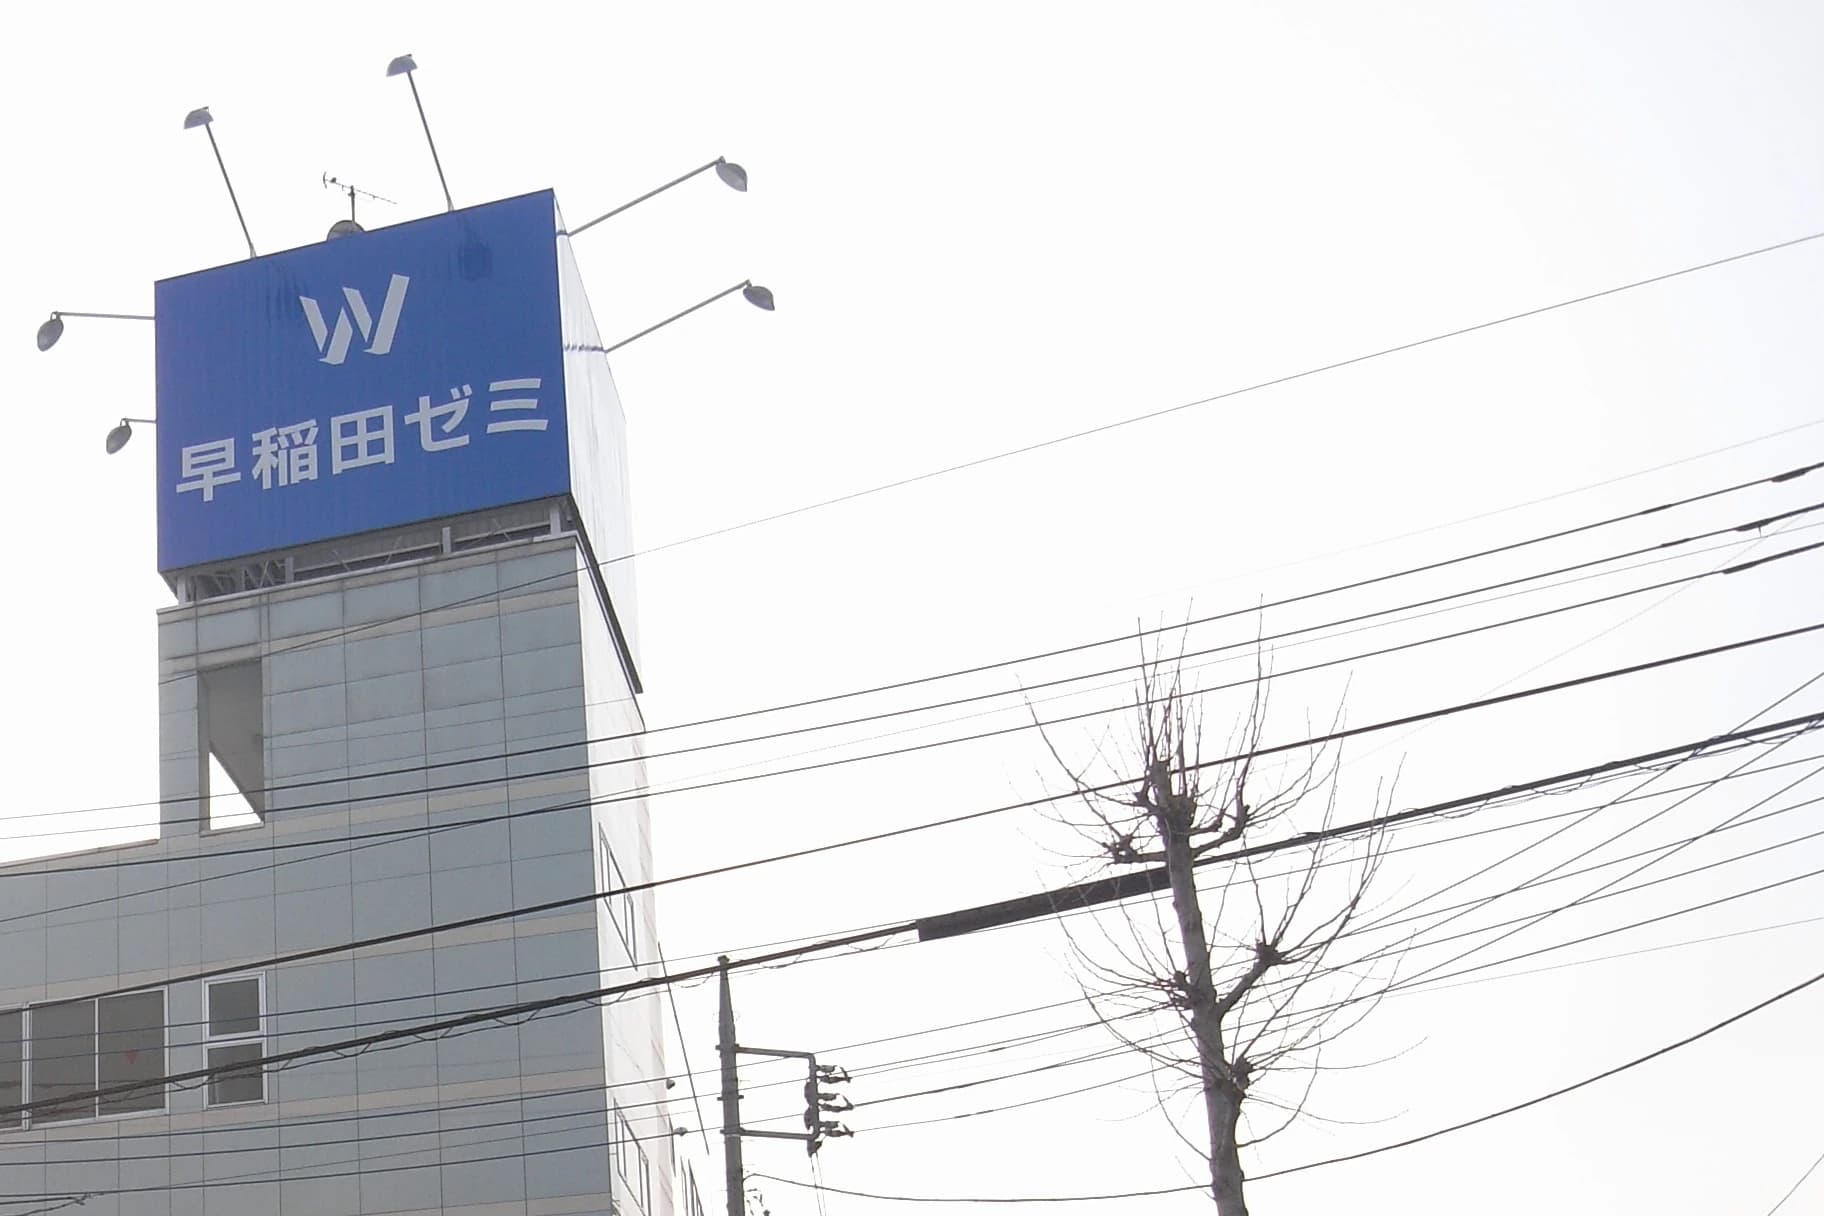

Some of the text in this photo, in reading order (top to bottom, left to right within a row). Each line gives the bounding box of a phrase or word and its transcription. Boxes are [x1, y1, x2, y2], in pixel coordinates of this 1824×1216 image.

[176, 377, 550, 503] 早稲田ゼミ
